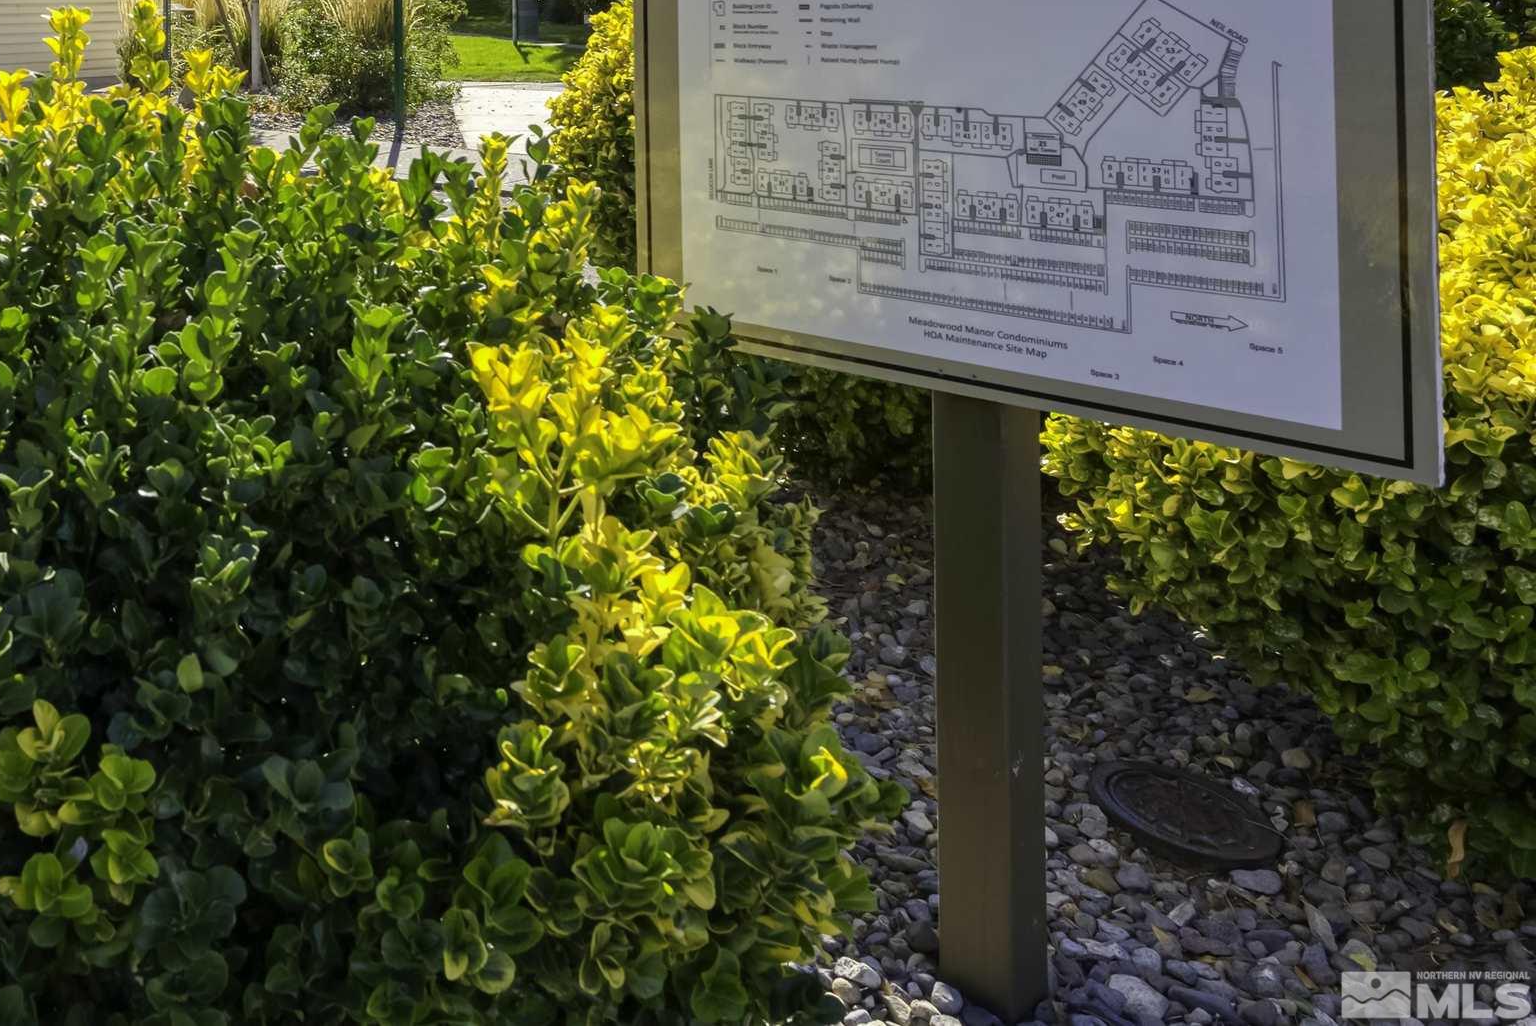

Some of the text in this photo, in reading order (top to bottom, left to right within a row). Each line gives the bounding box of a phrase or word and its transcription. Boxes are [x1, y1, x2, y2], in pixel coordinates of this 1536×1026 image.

[1209, 18, 1249, 44] NEIL ROAD
[908, 316, 1068, 350] Meadowood Manor Condominiums
[923, 329, 1048, 359] HOA Maintenance Site Map
[1249, 342, 1275, 353] Space
[1153, 355, 1176, 365] Space
[1090, 368, 1113, 378] Space
